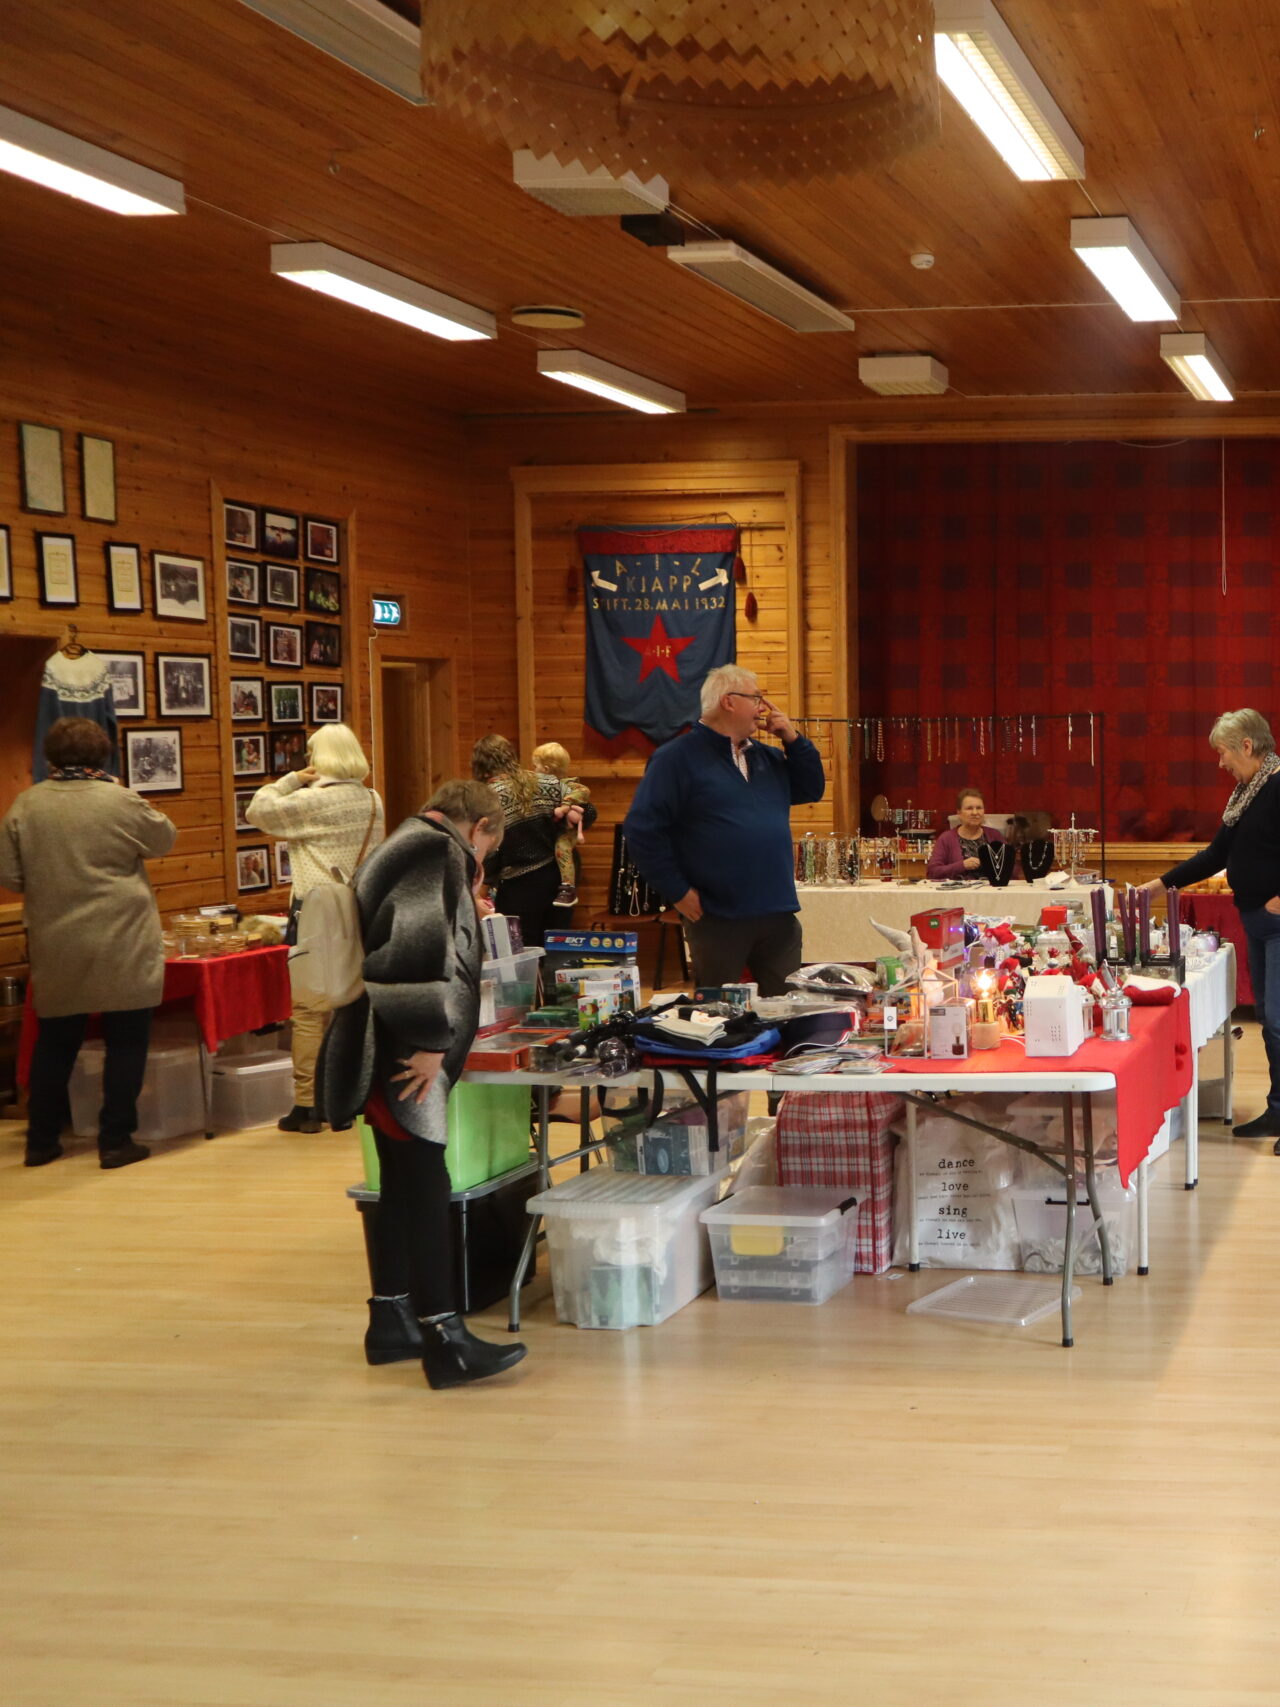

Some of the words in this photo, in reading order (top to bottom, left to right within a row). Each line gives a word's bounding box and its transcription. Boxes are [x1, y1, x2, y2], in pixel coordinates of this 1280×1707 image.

[593, 598, 631, 611] SIFT.
[655, 598, 689, 611] MAI
[695, 596, 726, 610] 1932
[938, 1158, 976, 1169] dance
[941, 1182, 969, 1192] love
[938, 1205, 968, 1218] sing
[937, 1228, 966, 1240] live
